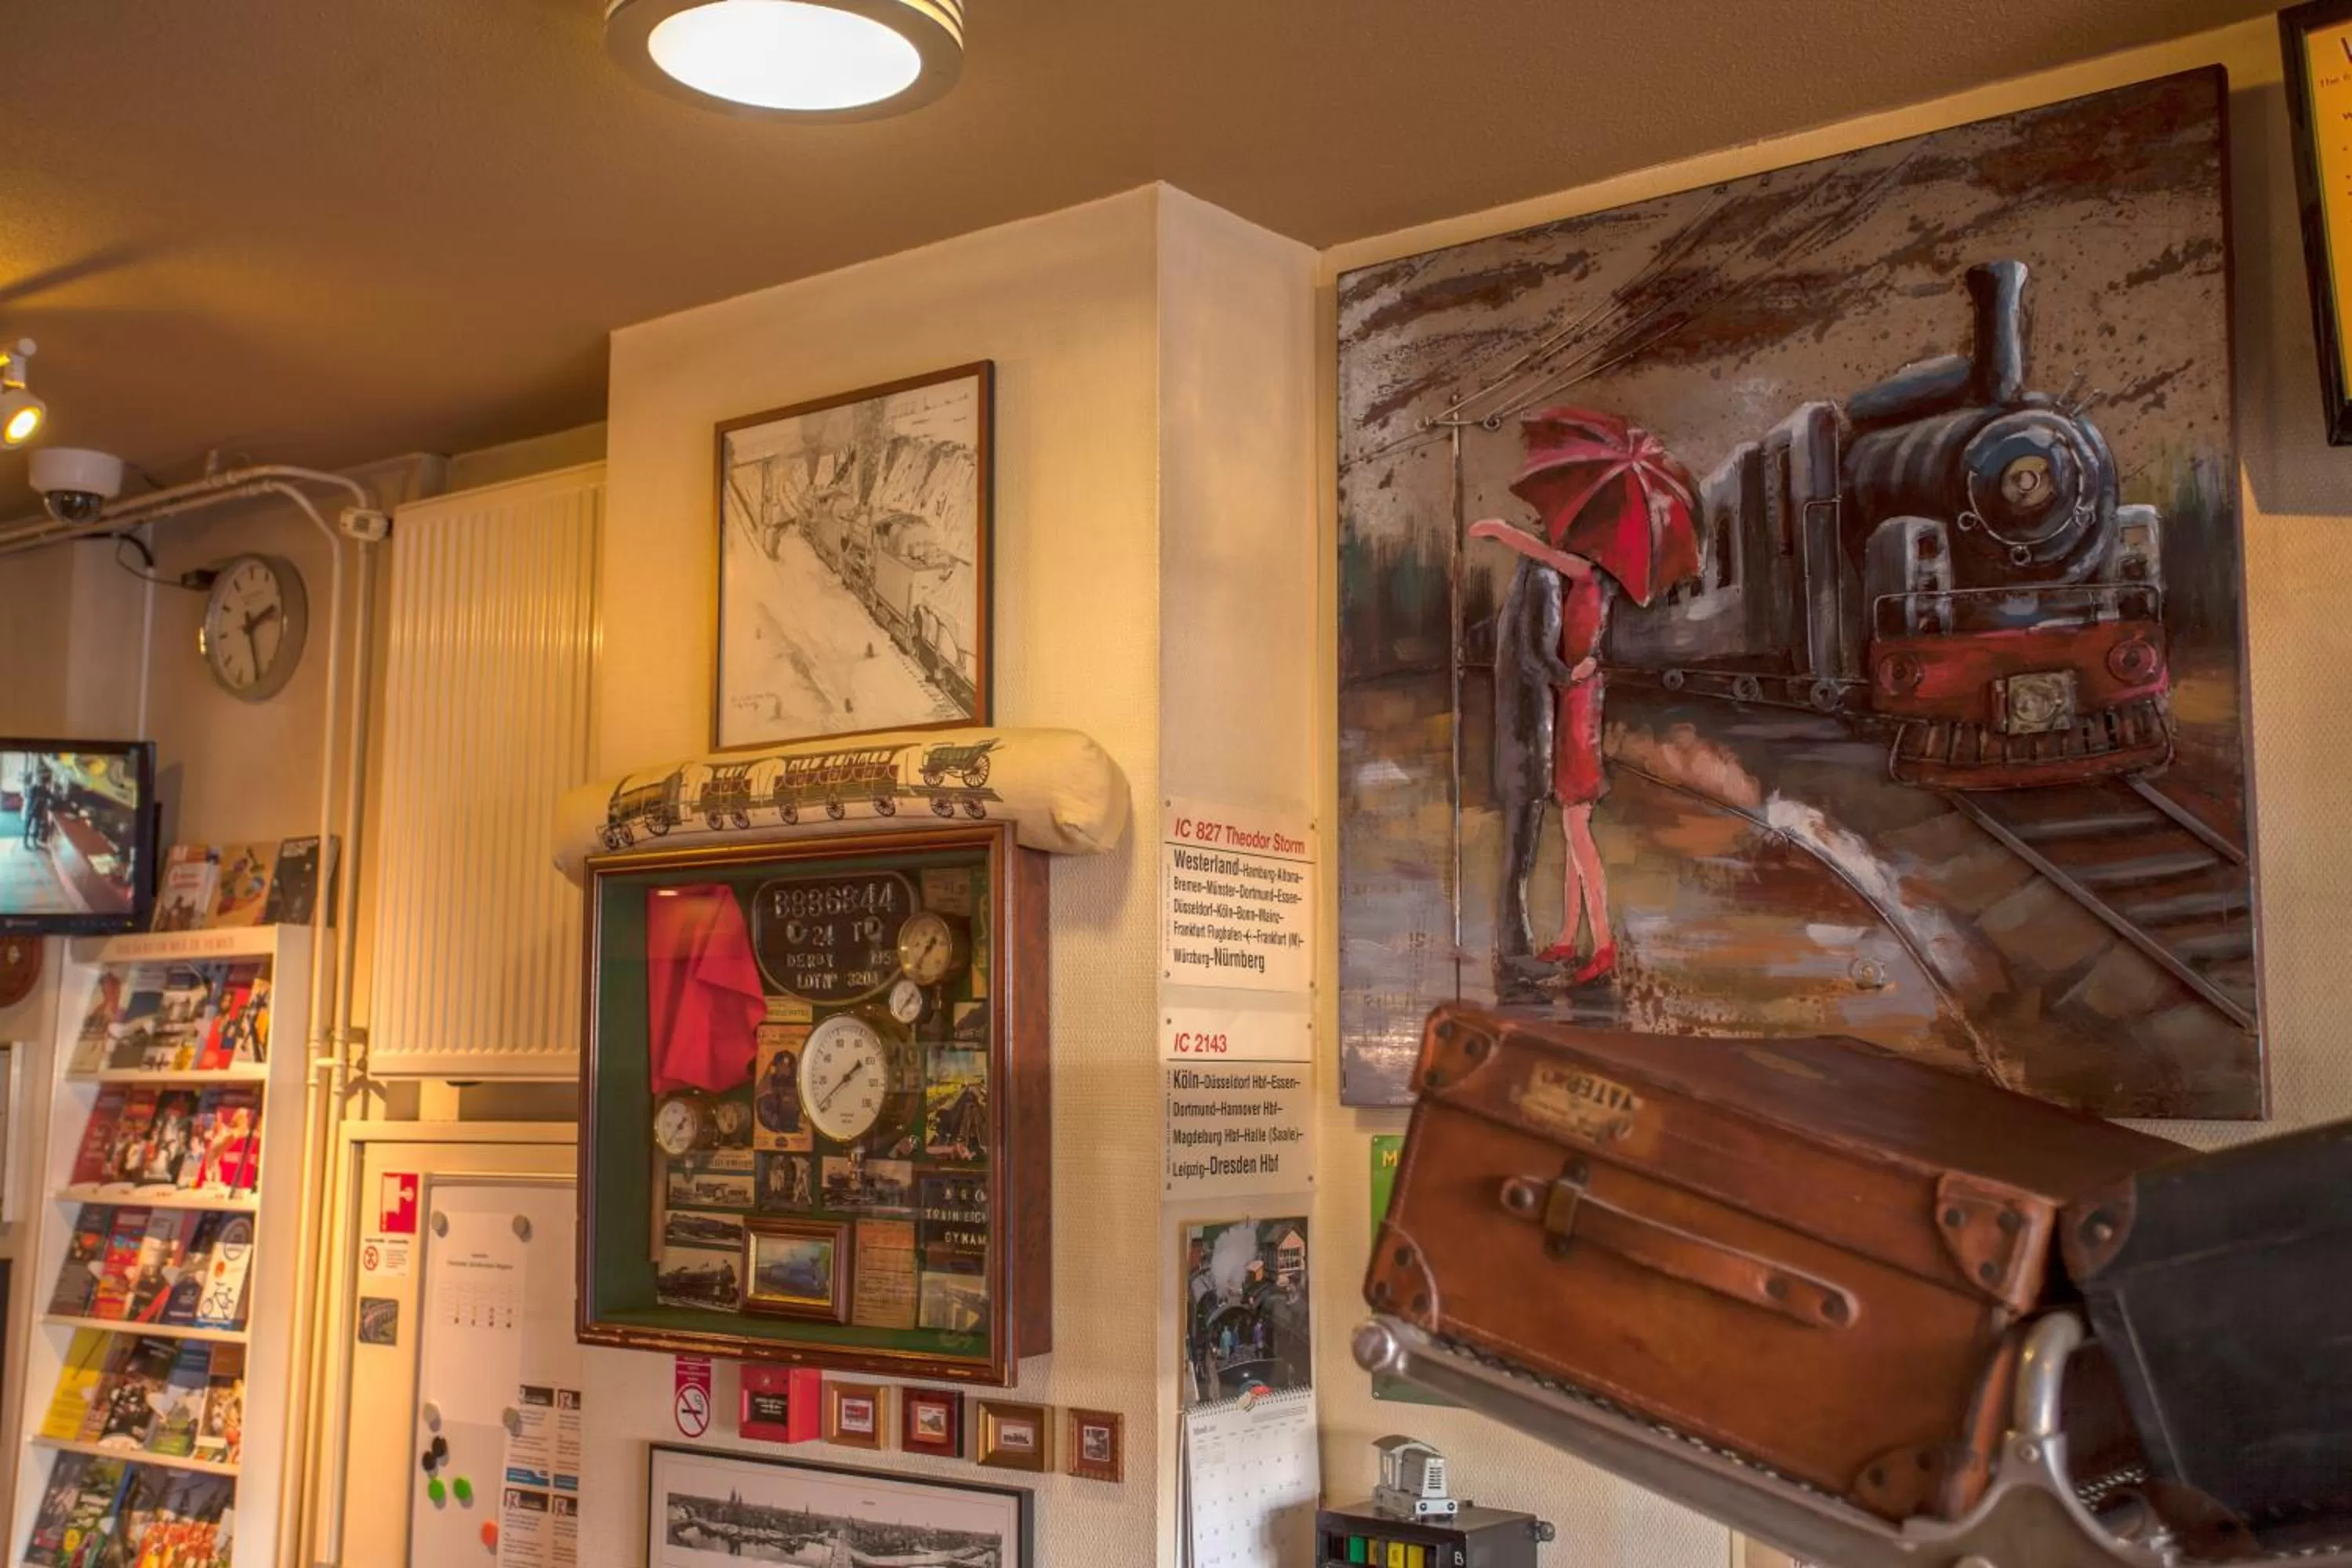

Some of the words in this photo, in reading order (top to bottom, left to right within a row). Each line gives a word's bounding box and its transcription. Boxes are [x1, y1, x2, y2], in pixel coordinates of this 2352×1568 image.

[1174, 818, 1192, 838] IC
[1196, 821, 1222, 843] 827
[1225, 825, 1271, 850] Theodor
[1272, 833, 1305, 855] Storm
[1174, 1033, 1190, 1053] IC
[1194, 1033, 1228, 1053] 2143
[1173, 1127, 1222, 1147] Magdeburg
[1260, 1153, 1279, 1174] Hbf
